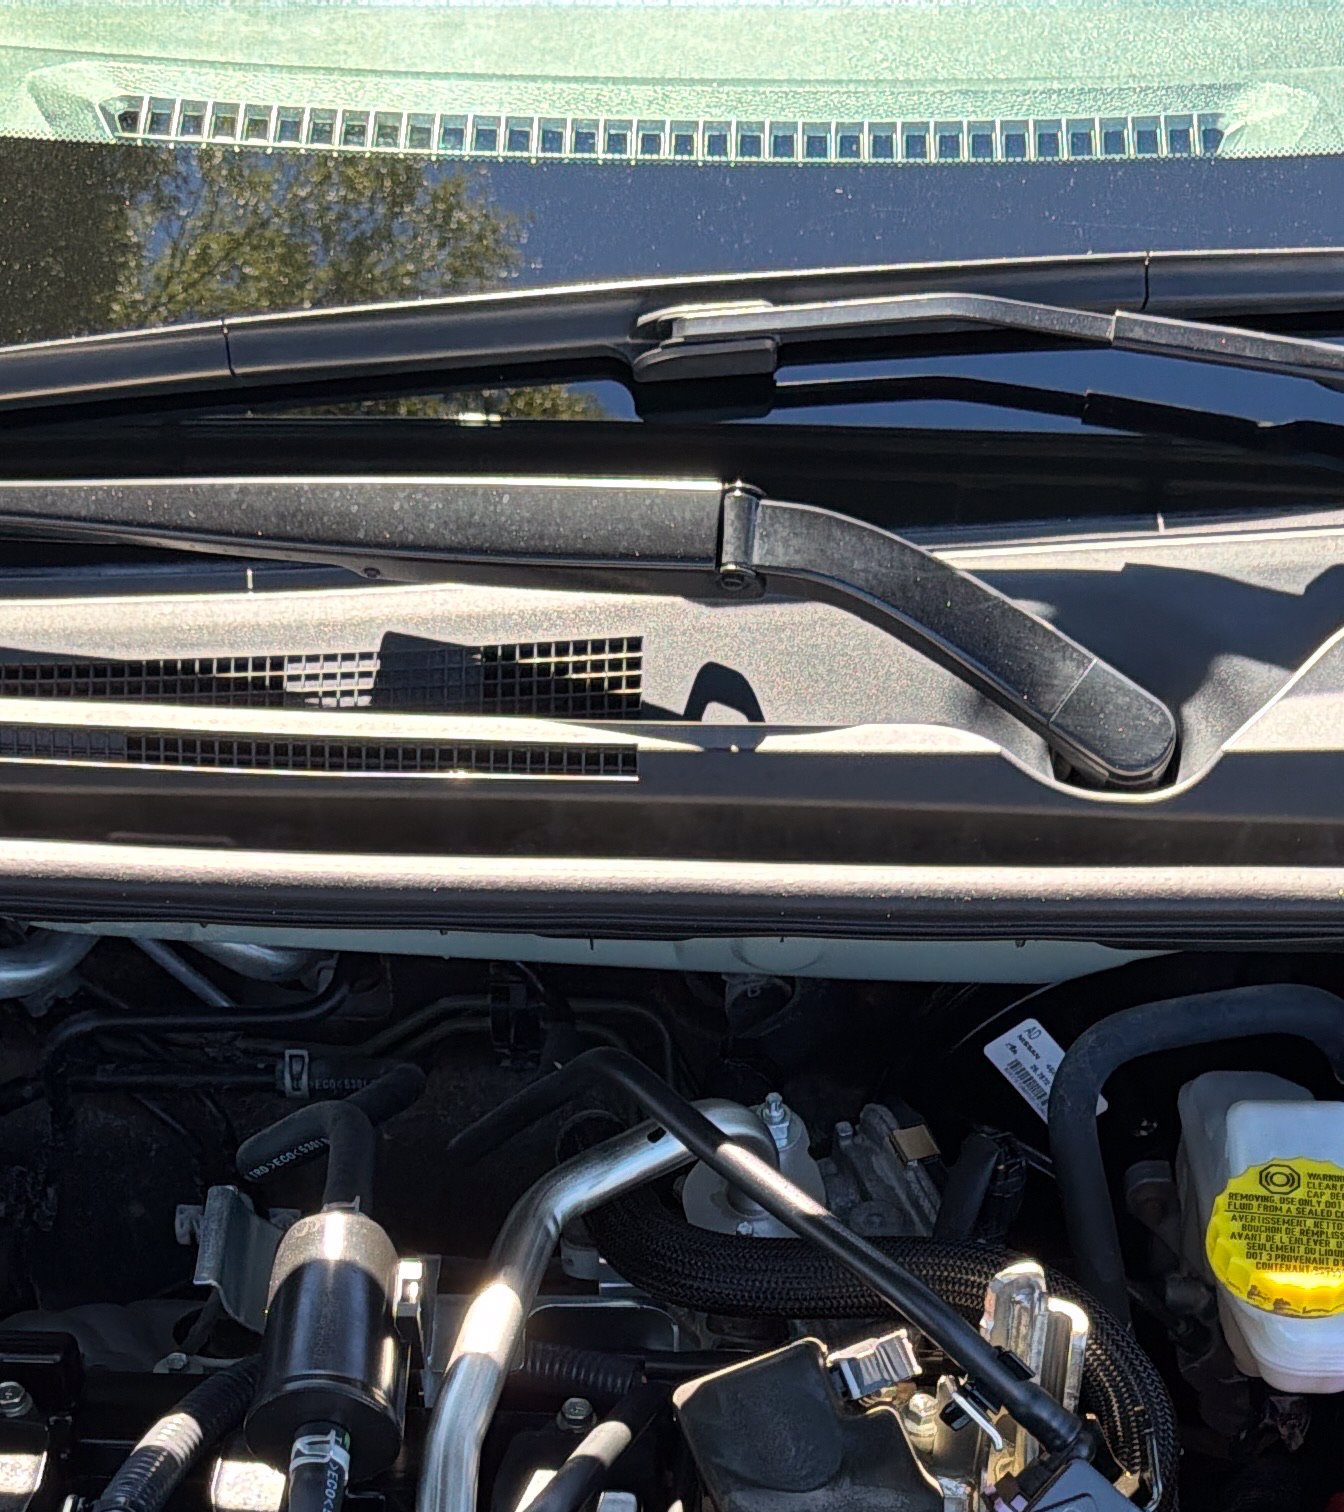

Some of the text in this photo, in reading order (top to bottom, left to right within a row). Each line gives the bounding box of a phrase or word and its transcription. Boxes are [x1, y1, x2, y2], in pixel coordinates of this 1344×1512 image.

[1307, 1181, 1337, 1191] CLEAN
[1307, 1190, 1326, 1199] CAP
[1279, 1197, 1297, 1206] USE
[1298, 1198, 1323, 1208] ONLY
[1325, 1200, 1342, 1209] DOT
[1227, 1201, 1254, 1211] FLUID
[1257, 1203, 1283, 1213] FROM
[1296, 1207, 1332, 1218] SEALED
[1242, 1224, 1283, 1235] BOUCHON
[1285, 1226, 1297, 1235] DE
[1230, 1232, 1262, 1242] AVANT
[1265, 1234, 1277, 1243] DE
[1246, 1242, 1301, 1254] SEULEMENT
[1304, 1247, 1317, 1256] DU
[1246, 1251, 1263, 1260] DOT
[1266, 1253, 1272, 1261] 3
[1274, 1253, 1329, 1266] PROVENANT
[1256, 1262, 1310, 1273] CONTENANT
